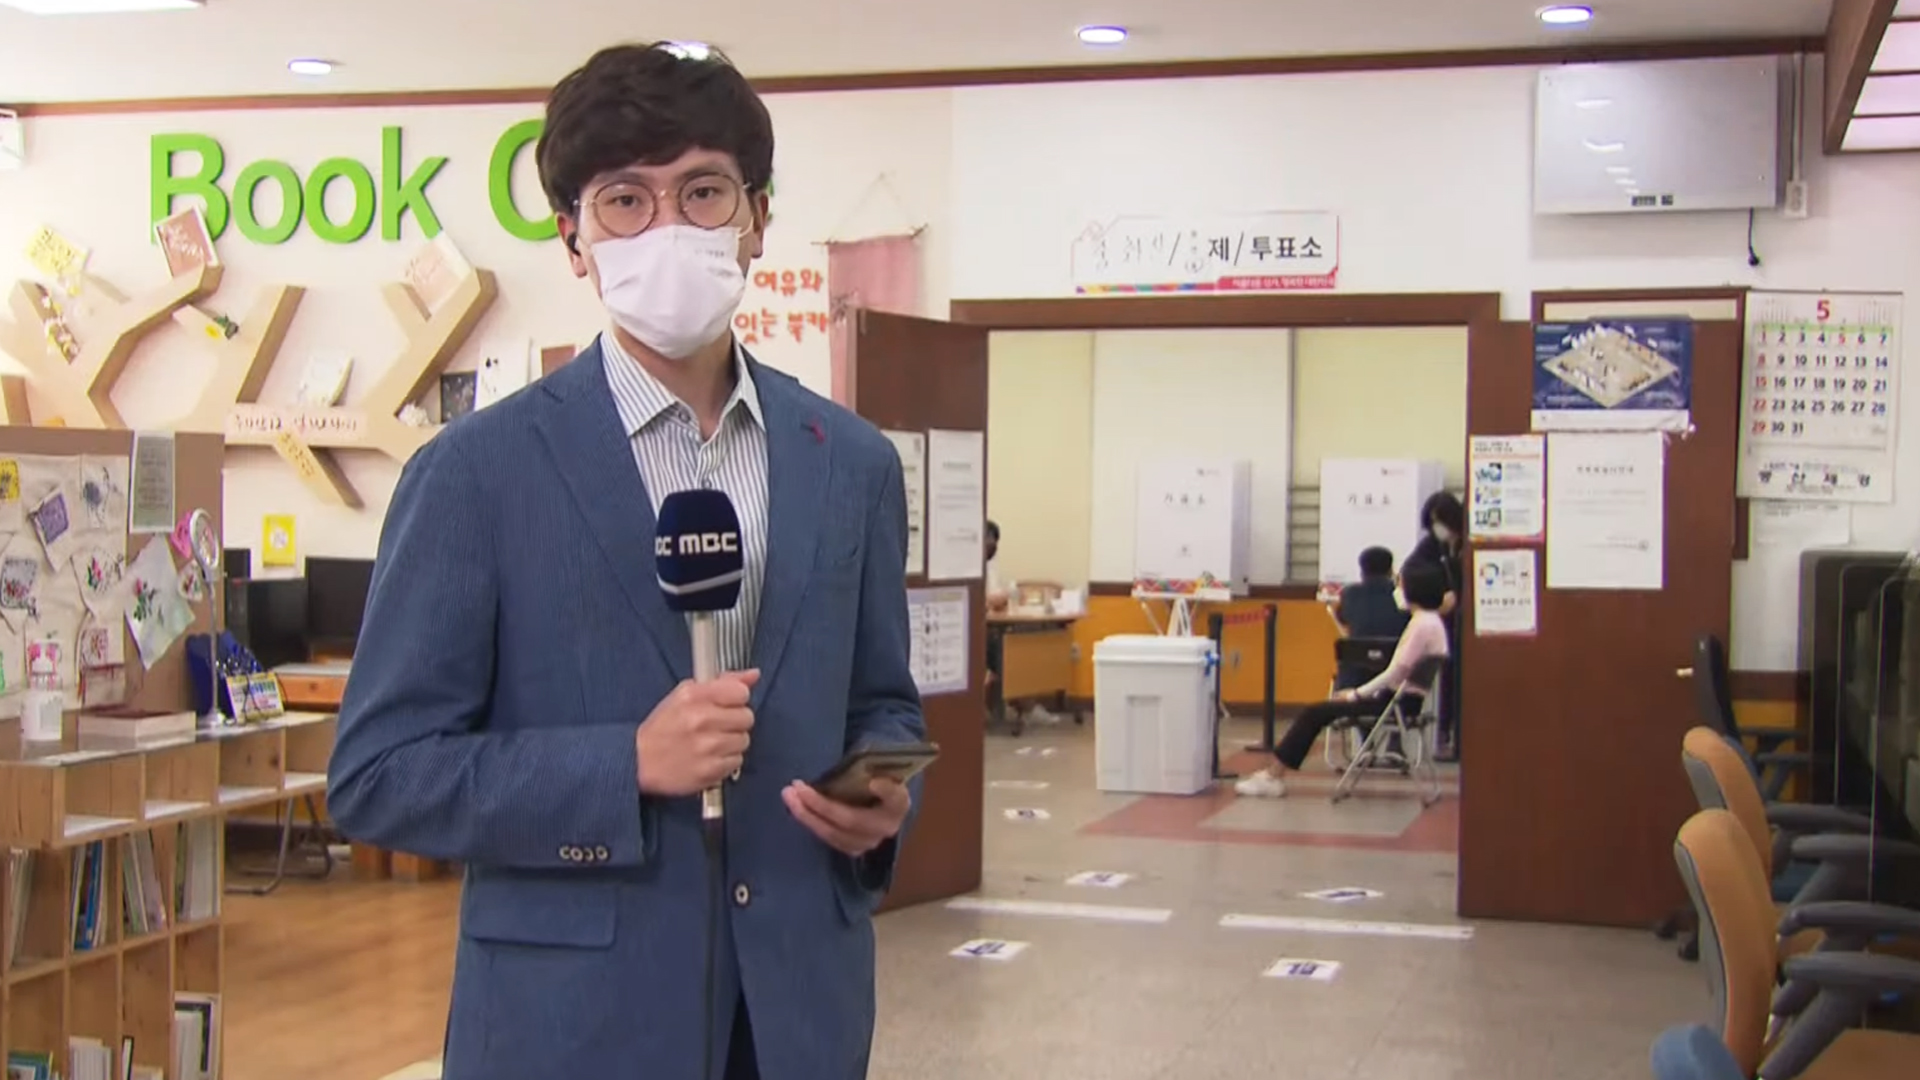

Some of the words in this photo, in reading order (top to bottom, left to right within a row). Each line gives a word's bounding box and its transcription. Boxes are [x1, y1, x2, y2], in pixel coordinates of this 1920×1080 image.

[150, 126, 449, 245] Book
[753, 268, 824, 297] 여유와
[1816, 299, 1830, 321] 5
[787, 311, 829, 344] 북카
[679, 531, 737, 554] MBC
